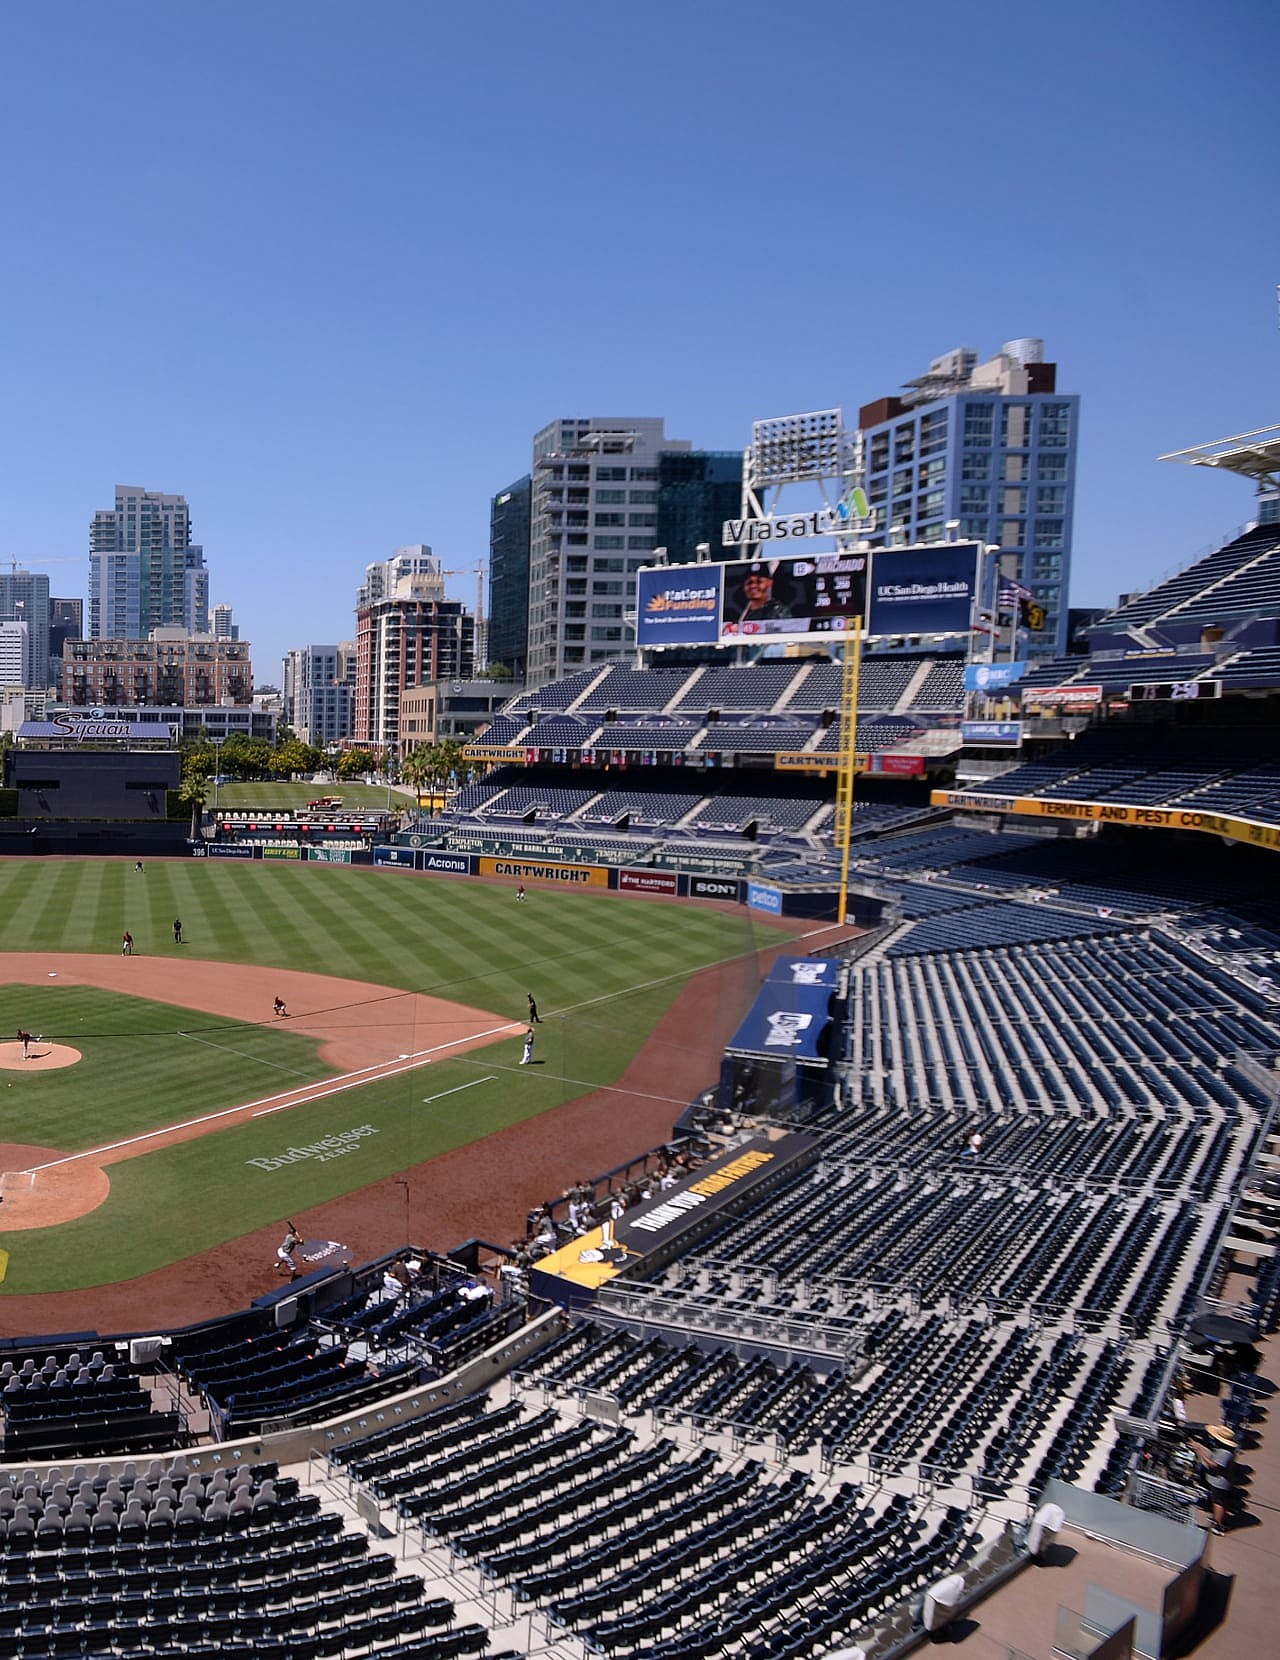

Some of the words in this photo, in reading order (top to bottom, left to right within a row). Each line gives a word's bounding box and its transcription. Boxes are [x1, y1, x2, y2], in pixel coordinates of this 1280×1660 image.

[728, 512, 825, 542] Viasat
[816, 558, 865, 574] MACHADO
[664, 587, 716, 601] National
[877, 585, 894, 597] UC
[894, 584, 912, 596] San
[912, 583, 938, 595] Diego
[938, 581, 969, 593] Health
[665, 599, 716, 611] Funding
[51, 712, 132, 743] Sycuan
[463, 749, 525, 759] CARTWRIGHT
[1039, 801, 1093, 817] TERMITE
[1100, 806, 1128, 820] AND
[1135, 809, 1173, 824] PEST
[448, 837, 483, 848] TEMPLETON
[511, 843, 523, 851] THE
[524, 844, 546, 853] BARREL
[547, 846, 564, 854] DECK
[595, 849, 637, 860] TEMPLETON
[427, 856, 466, 870] Acronis
[495, 862, 591, 882] CARTWRIGHT
[628, 876, 640, 884] THE
[640, 877, 676, 888] HARTFORD
[752, 890, 779, 907] petco
[244, 1123, 381, 1173] Budweiser
[313, 1143, 361, 1163] ZERO
[629, 1202, 688, 1233] THANK
[666, 1190, 707, 1210] YOU
